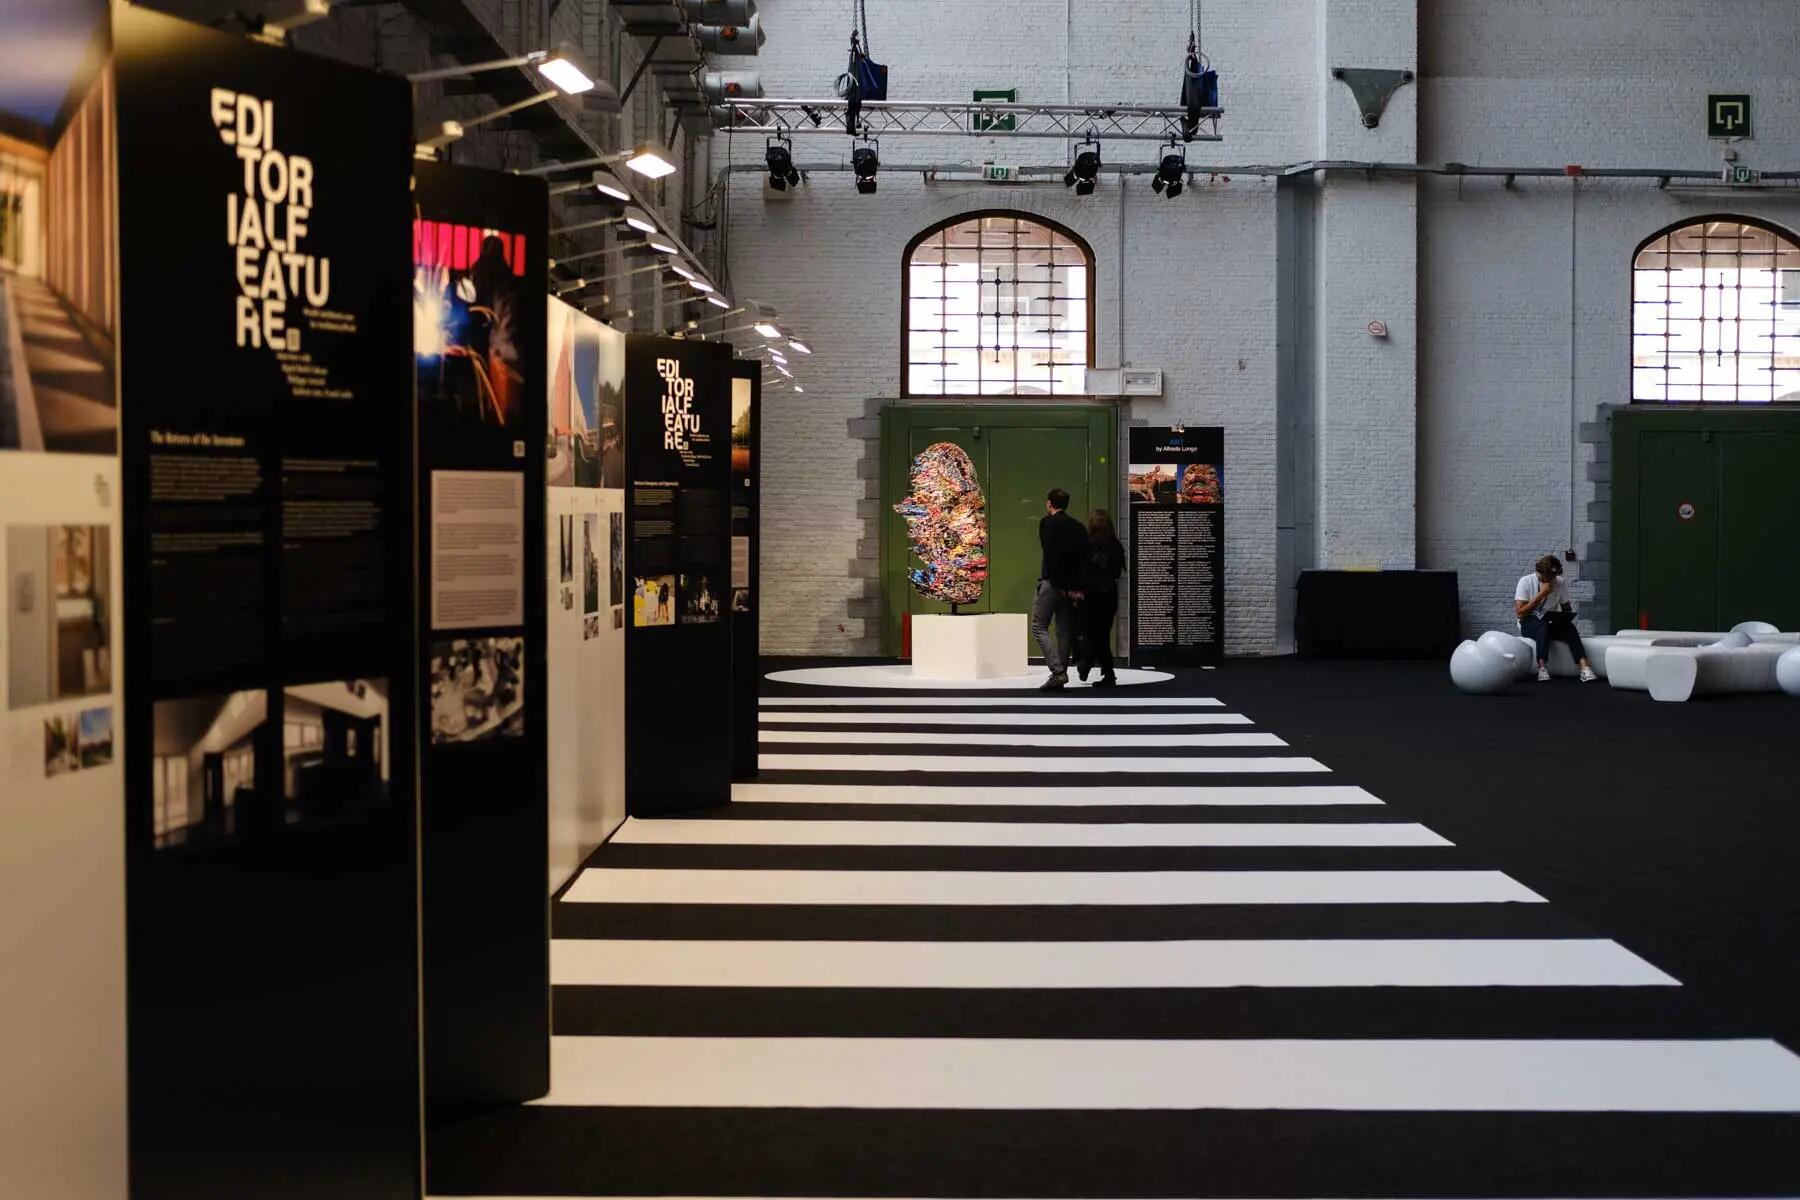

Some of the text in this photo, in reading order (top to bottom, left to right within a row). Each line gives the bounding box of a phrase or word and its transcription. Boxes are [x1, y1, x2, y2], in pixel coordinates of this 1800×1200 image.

[211, 87, 273, 151] EDI
[236, 145, 313, 209] TOR
[227, 192, 309, 254] IALF
[236, 246, 330, 308] EATU
[236, 295, 287, 351] RE
[657, 358, 680, 378] EDI
[662, 395, 692, 414] IALF
[666, 377, 694, 398] TOR
[664, 431, 684, 450] RE
[665, 413, 701, 433] EATU
